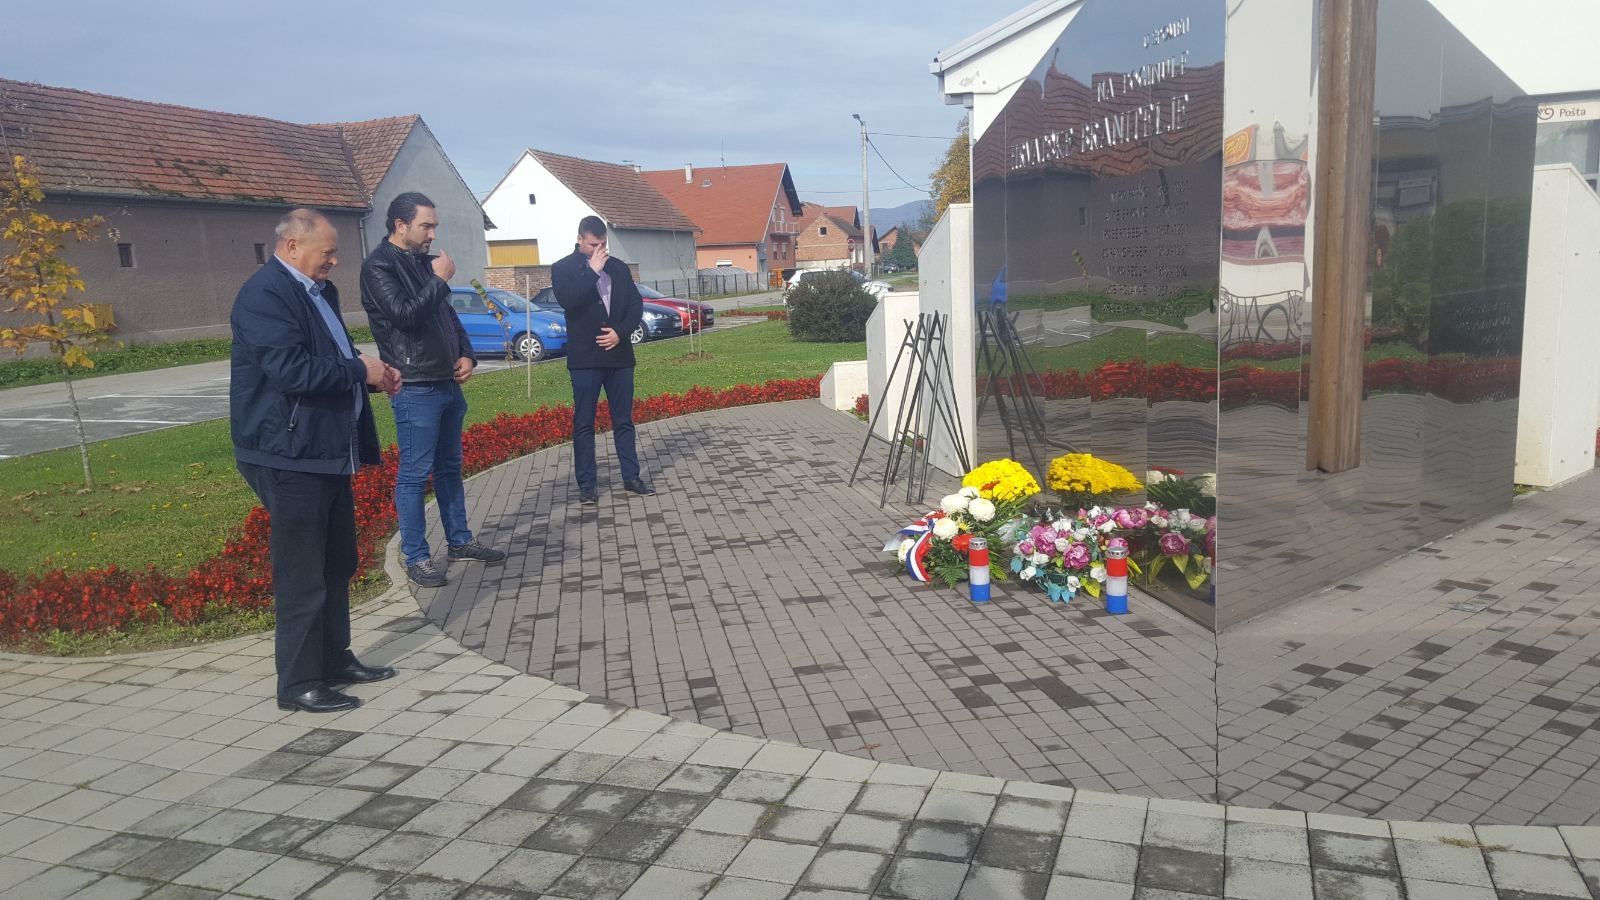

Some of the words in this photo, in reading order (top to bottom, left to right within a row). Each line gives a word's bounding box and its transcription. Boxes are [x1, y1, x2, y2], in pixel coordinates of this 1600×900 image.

[1096, 77, 1115, 103] NA
[1080, 93, 1190, 154] BRANITELJE
[1559, 107, 1586, 118] Pošta
